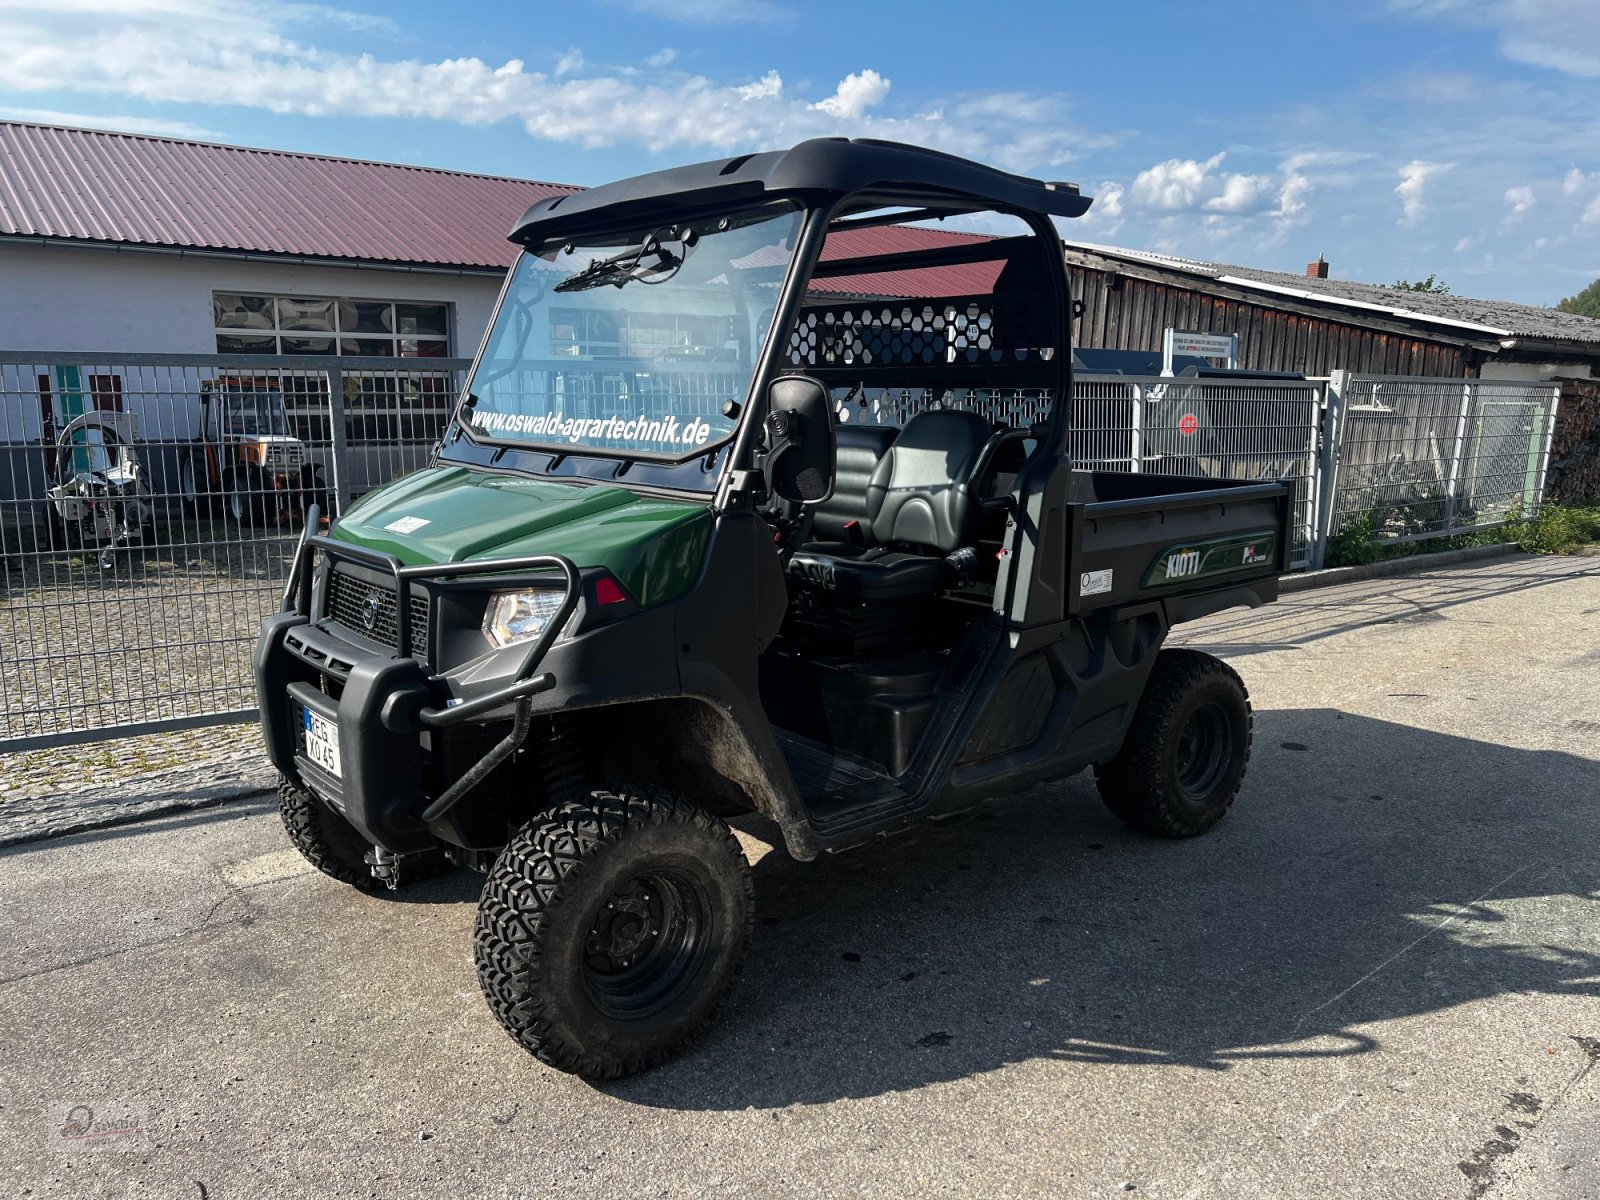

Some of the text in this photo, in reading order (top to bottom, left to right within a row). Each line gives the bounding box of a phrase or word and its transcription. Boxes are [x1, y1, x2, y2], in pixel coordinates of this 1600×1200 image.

[470, 411, 709, 444] www.oswald-agrartechnik.de
[1165, 551, 1200, 579] KIOTI
[323, 746, 335, 770] 45
